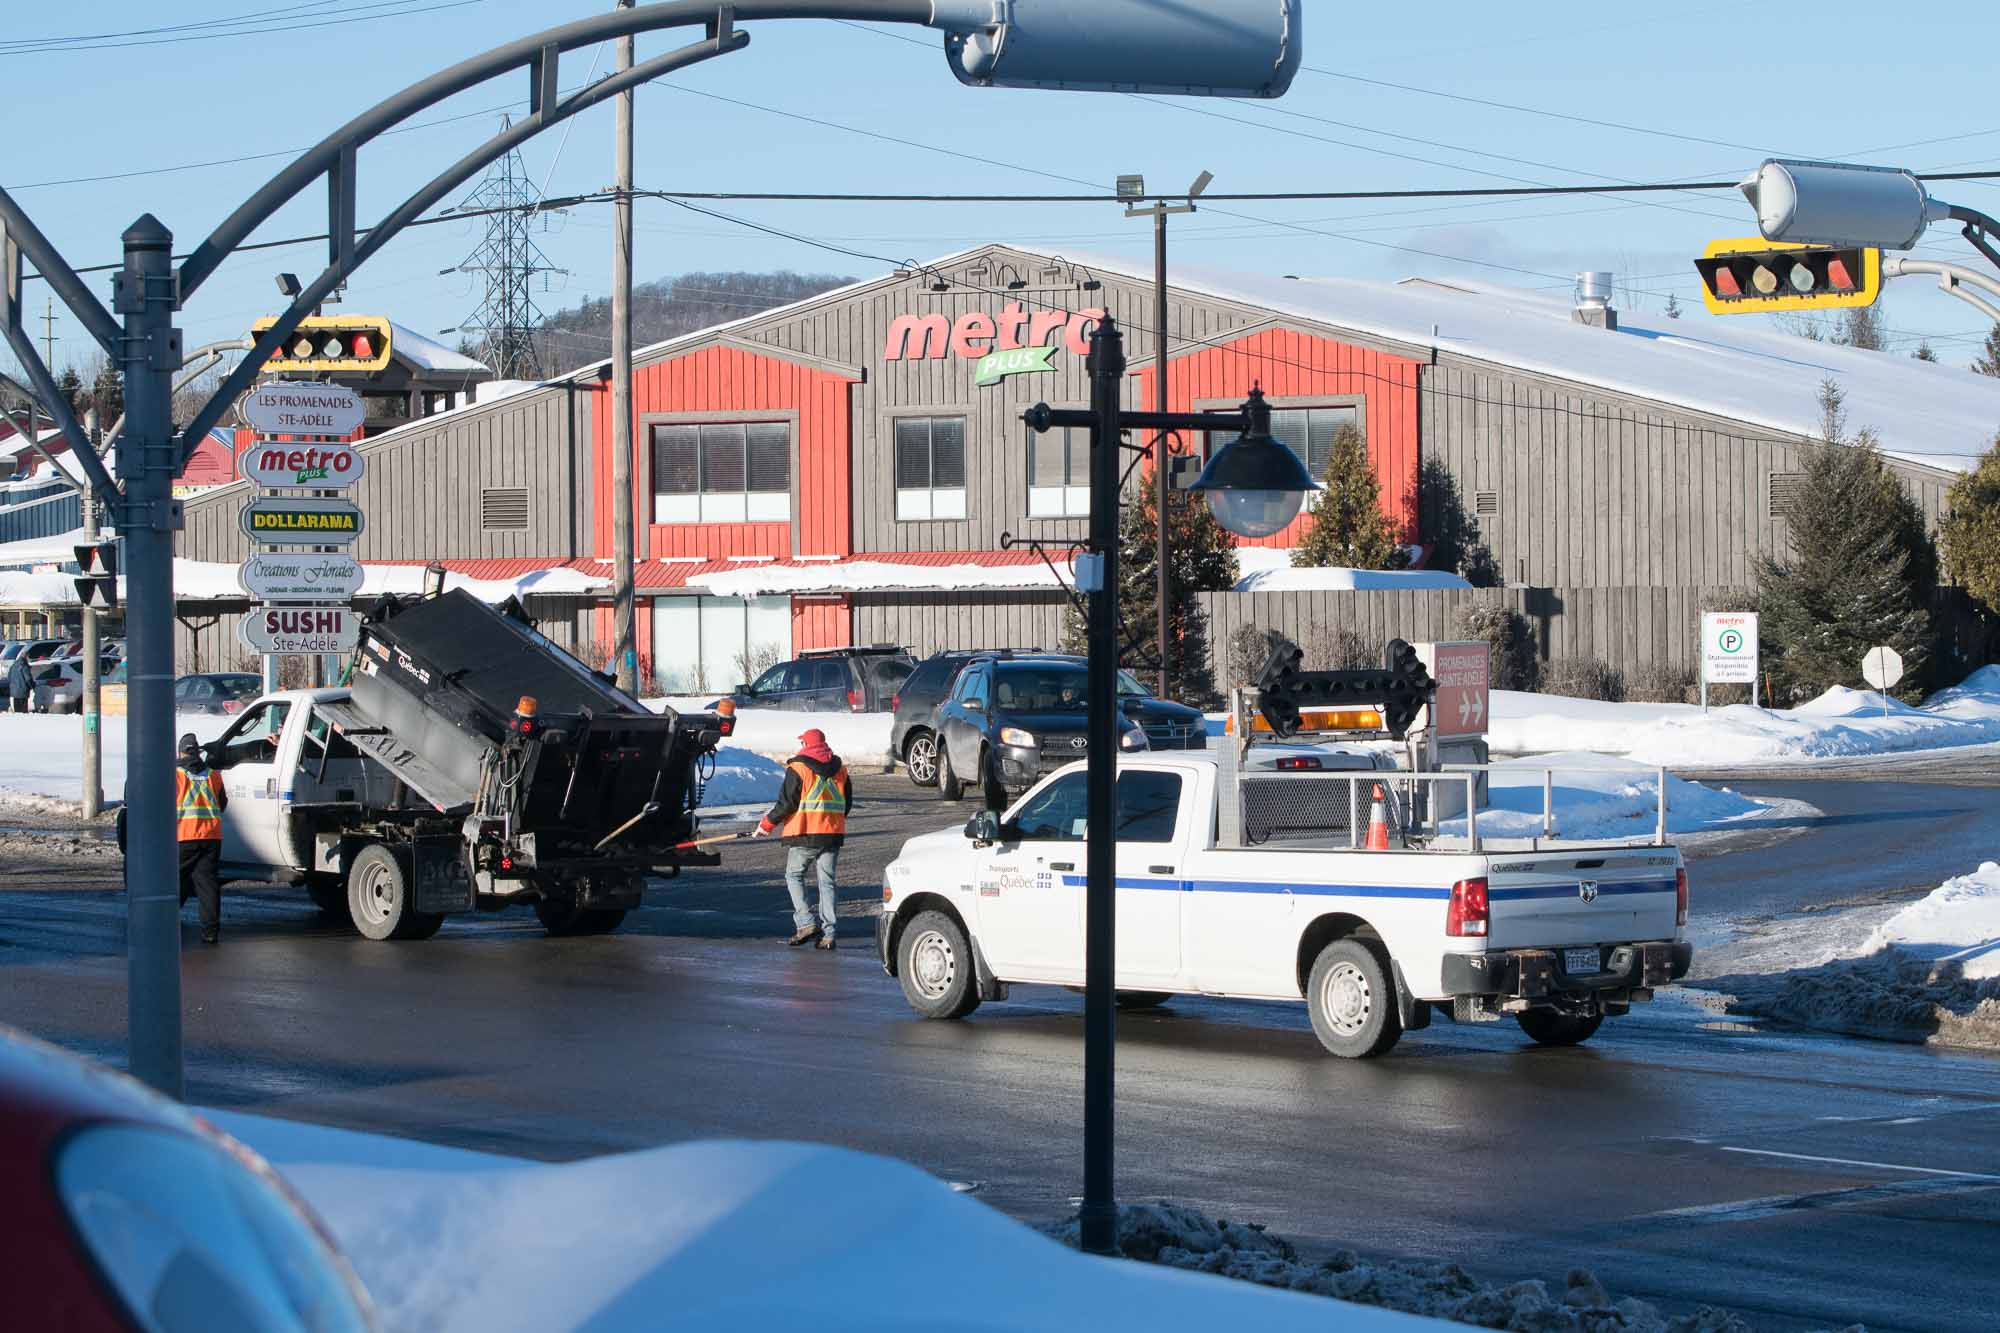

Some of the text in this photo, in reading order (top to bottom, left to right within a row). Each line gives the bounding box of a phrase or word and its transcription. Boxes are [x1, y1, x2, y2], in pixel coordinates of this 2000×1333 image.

[884, 300, 1106, 360] metro
[983, 351, 1034, 374] PLUS
[259, 395, 353, 409] LES PROMENADES
[259, 448, 352, 472] metro
[299, 468, 321, 478] PLUS
[254, 514, 354, 529] DOLLARAMA
[304, 560, 356, 583] Florales
[266, 611, 342, 634] SUSHI
[1716, 617, 1745, 625] metro
[273, 636, 338, 651] Ste-Adèle
[1000, 873, 1035, 890] Québec
